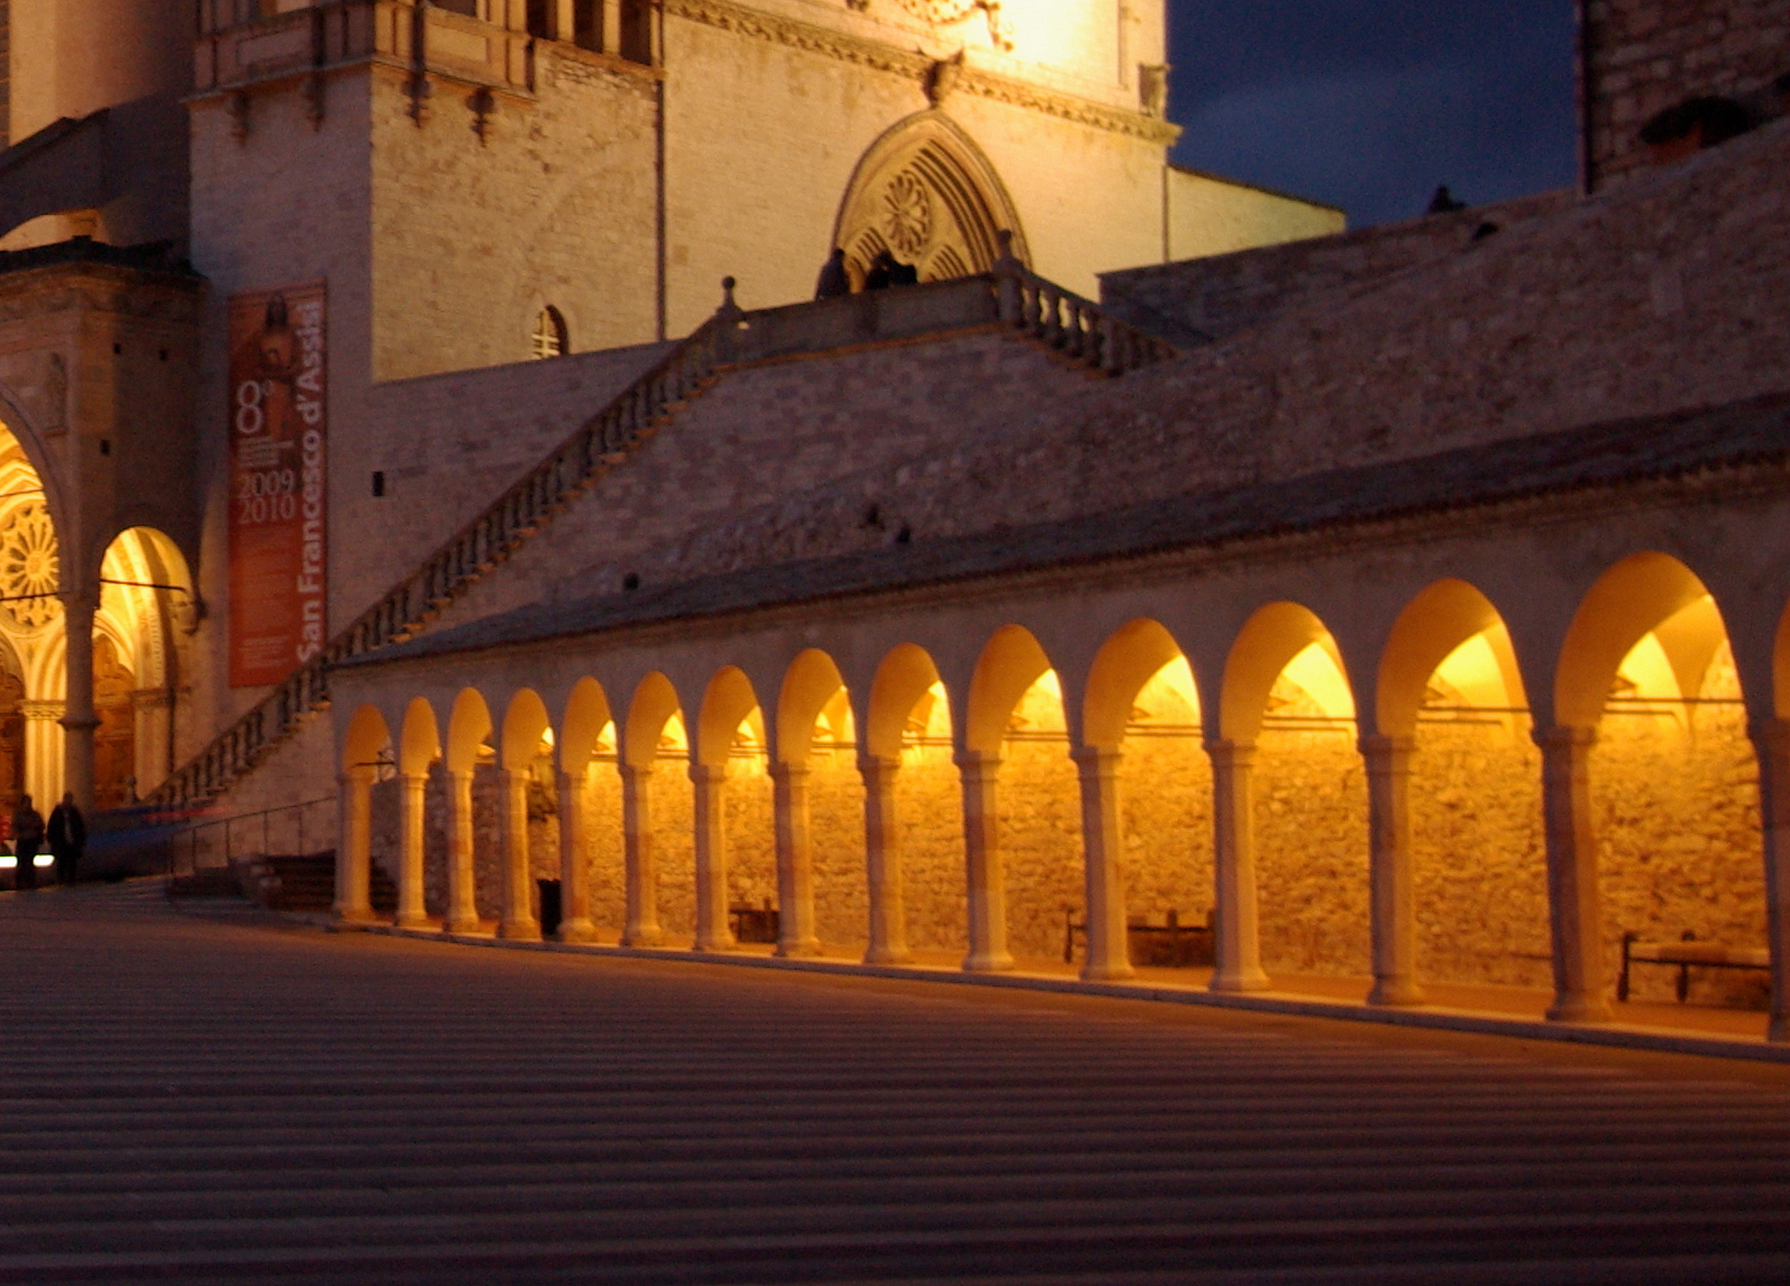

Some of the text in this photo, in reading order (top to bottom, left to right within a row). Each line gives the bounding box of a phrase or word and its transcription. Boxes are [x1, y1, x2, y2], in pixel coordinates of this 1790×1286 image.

[237, 469, 295, 499] 2009
[295, 301, 322, 662] San Francesco d'Assisi
[238, 494, 296, 525] 2010
